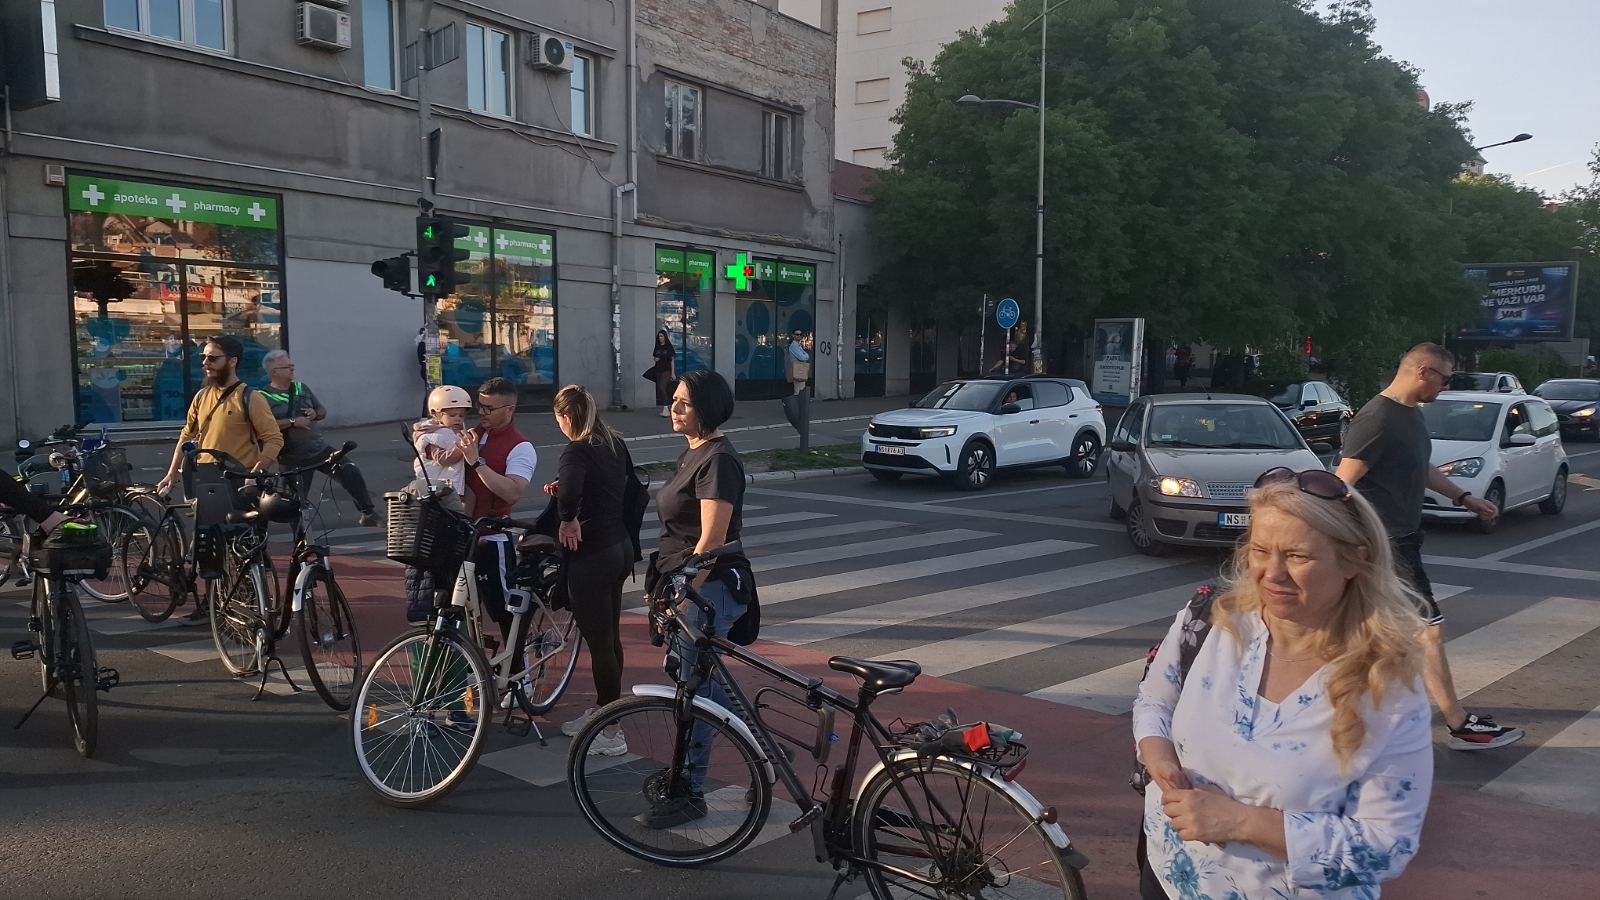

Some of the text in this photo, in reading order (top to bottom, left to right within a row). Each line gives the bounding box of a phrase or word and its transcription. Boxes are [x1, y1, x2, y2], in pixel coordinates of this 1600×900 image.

[114, 193, 240, 215] apoteka pharmacy
[509, 240, 538, 250] pharmacy
[688, 260, 710, 268] pharmacy
[1491, 284, 1546, 297] MERKURU
[1522, 293, 1545, 304] VAR
[1226, 514, 1240, 525] NS
